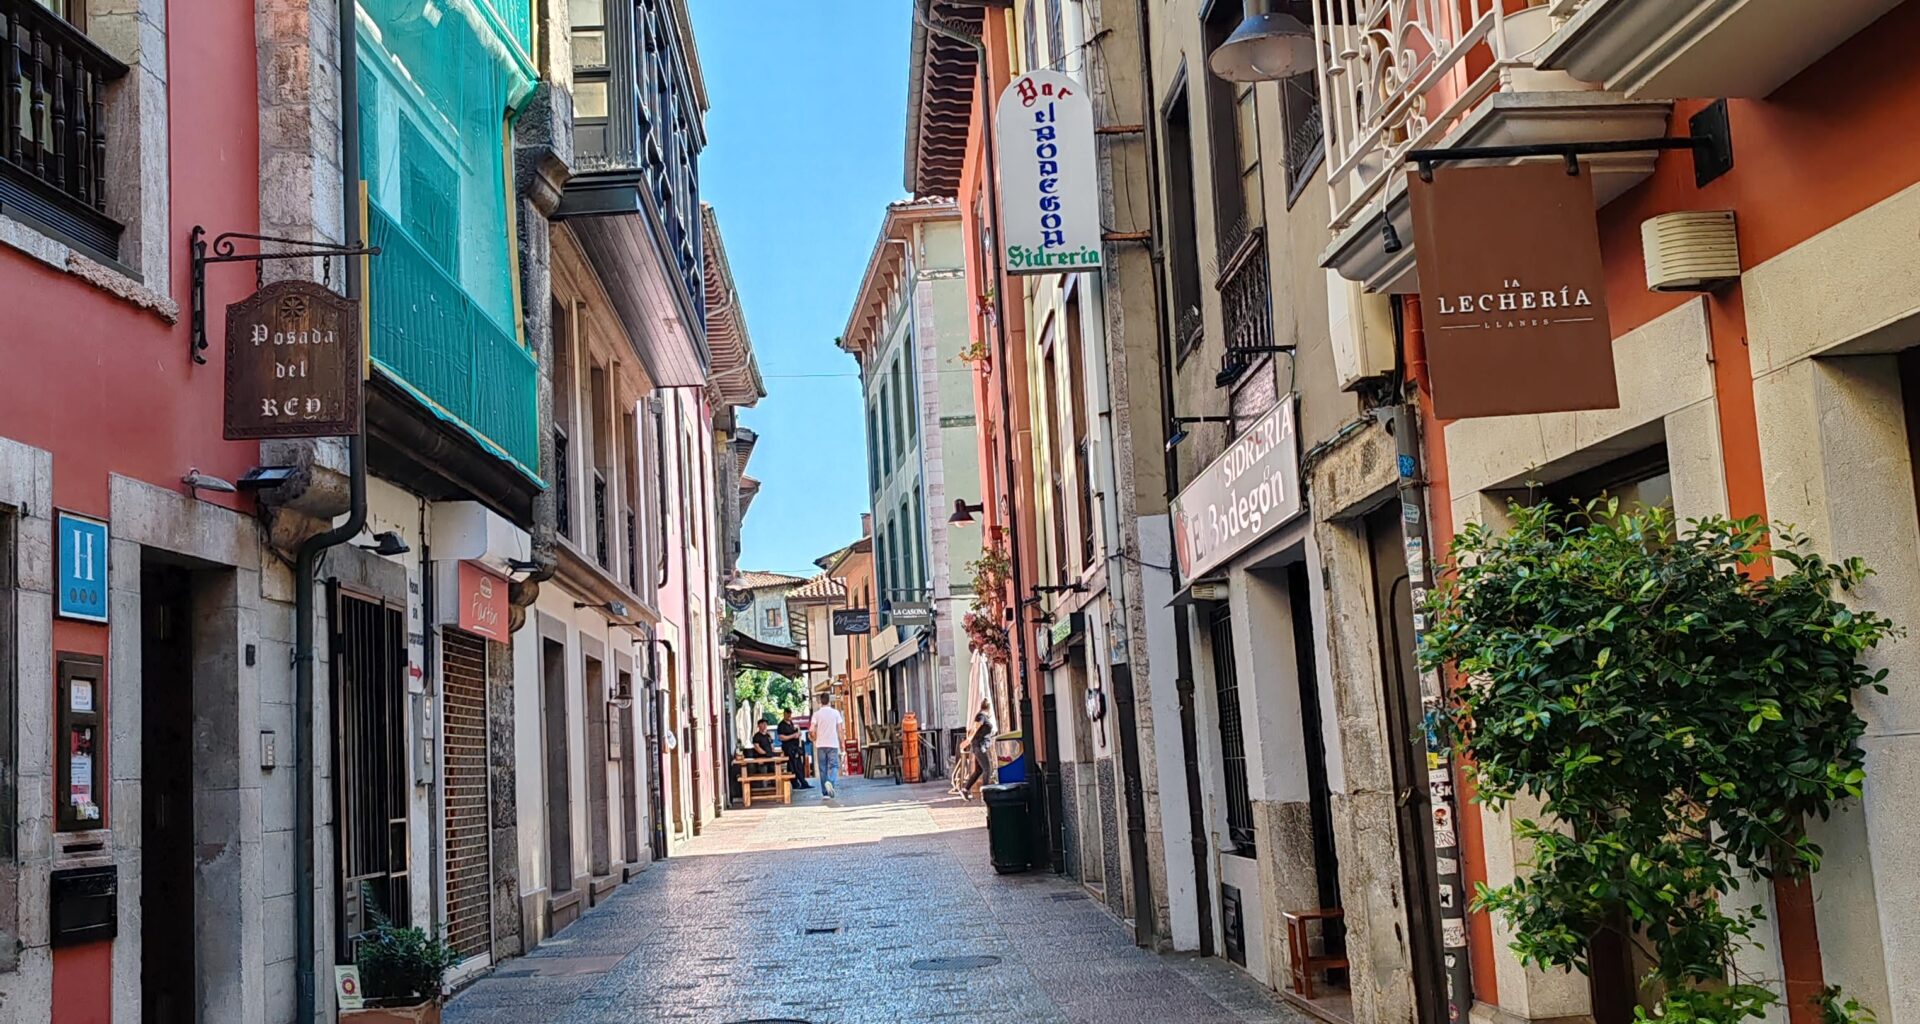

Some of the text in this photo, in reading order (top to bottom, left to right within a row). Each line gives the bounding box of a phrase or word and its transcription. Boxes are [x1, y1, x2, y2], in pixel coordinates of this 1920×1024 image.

[1013, 76, 1073, 107] Bar
[1035, 102, 1056, 123] el
[1438, 285, 1592, 314] LECHERÍA
[1485, 318, 1550, 329] LLANES
[250, 324, 334, 346] Posada
[275, 361, 306, 378] del
[261, 397, 321, 419] REY
[1223, 403, 1293, 488] SIDRERIA
[73, 529, 95, 581] H
